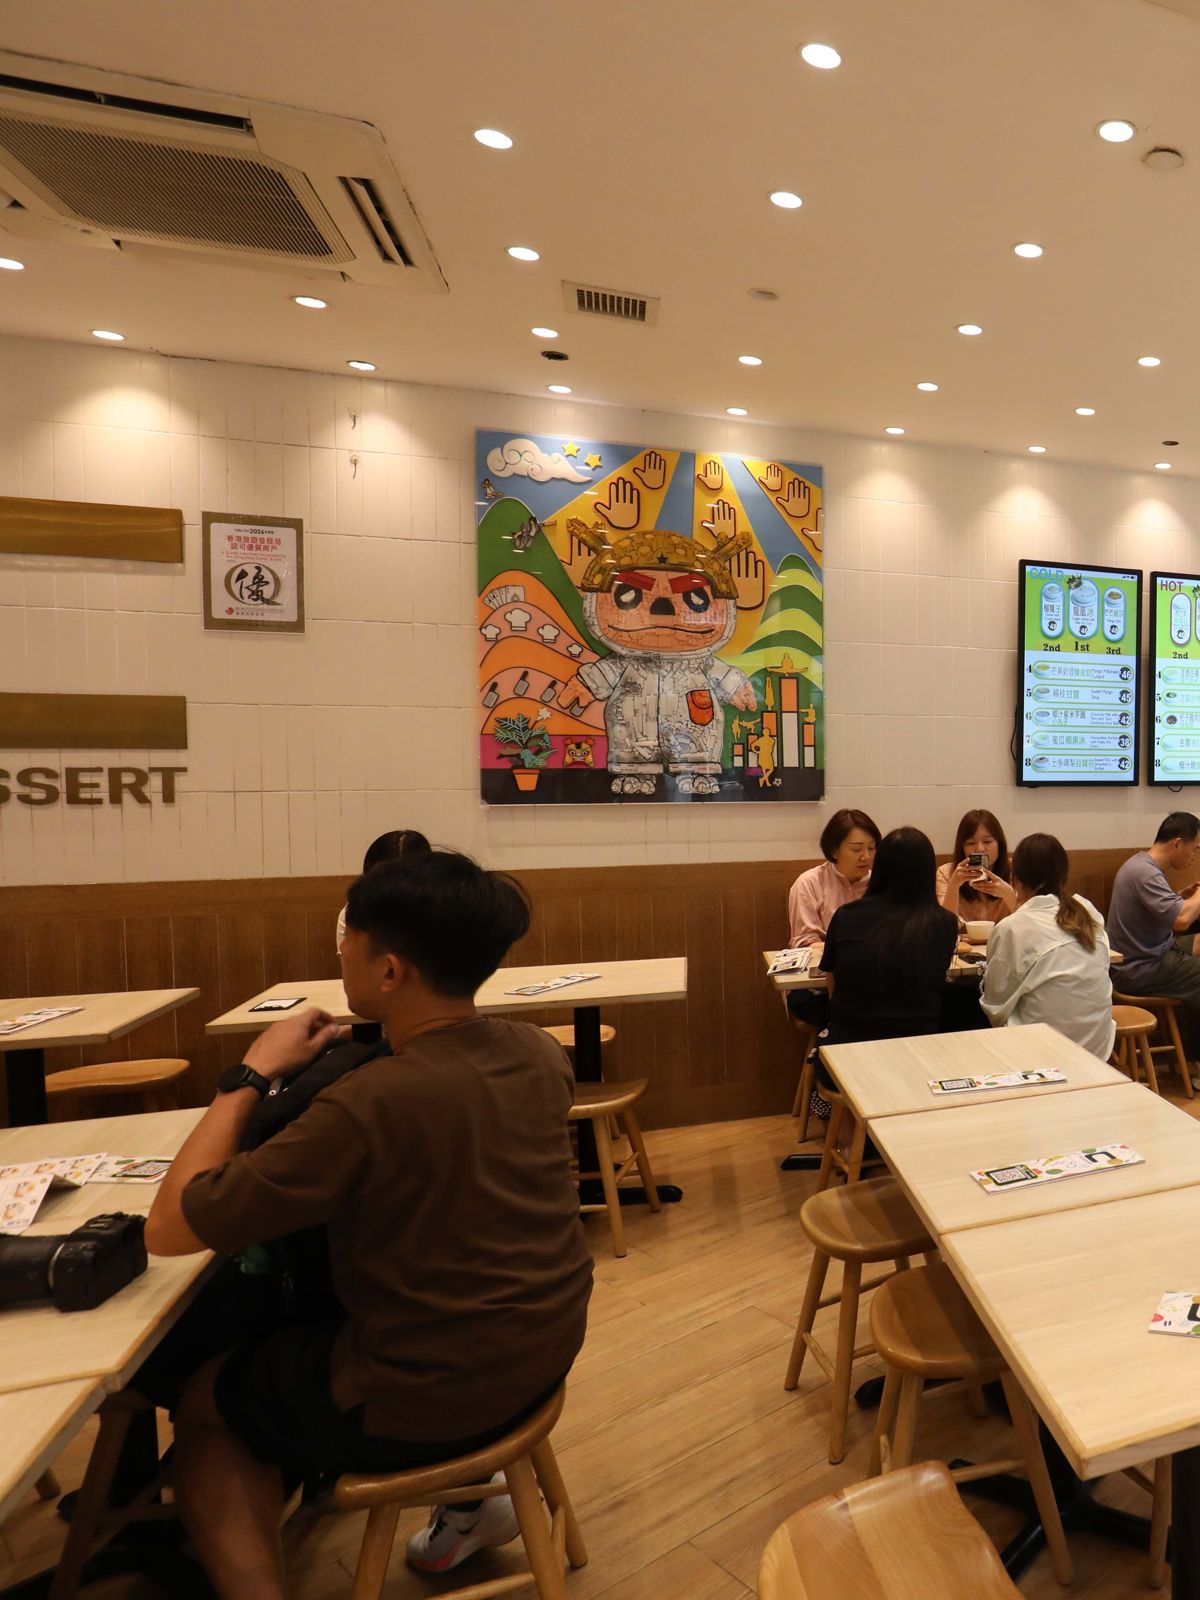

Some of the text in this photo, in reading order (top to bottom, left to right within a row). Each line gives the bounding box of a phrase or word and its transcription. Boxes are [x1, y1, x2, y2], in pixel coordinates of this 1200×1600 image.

[1029, 568, 1065, 581] COLD
[1160, 580, 1183, 592] HOT
[1043, 643, 1061, 652] 2nd
[1074, 641, 1090, 652] 1st
[1106, 647, 1121, 655] 3rd
[1172, 651, 1189, 660] 2nd
[1121, 670, 1132, 679] 46
[1026, 688, 1032, 697] 5
[1121, 693, 1131, 702] 45
[1025, 712, 1032, 721] 6
[1121, 716, 1130, 724] 42
[1155, 716, 1161, 724] 6
[1025, 735, 1031, 744] 7
[1025, 758, 1032, 767] 8
[1119, 760, 1129, 769] 42
[1154, 759, 1161, 768] 8
[0, 766, 188, 806] SERT
